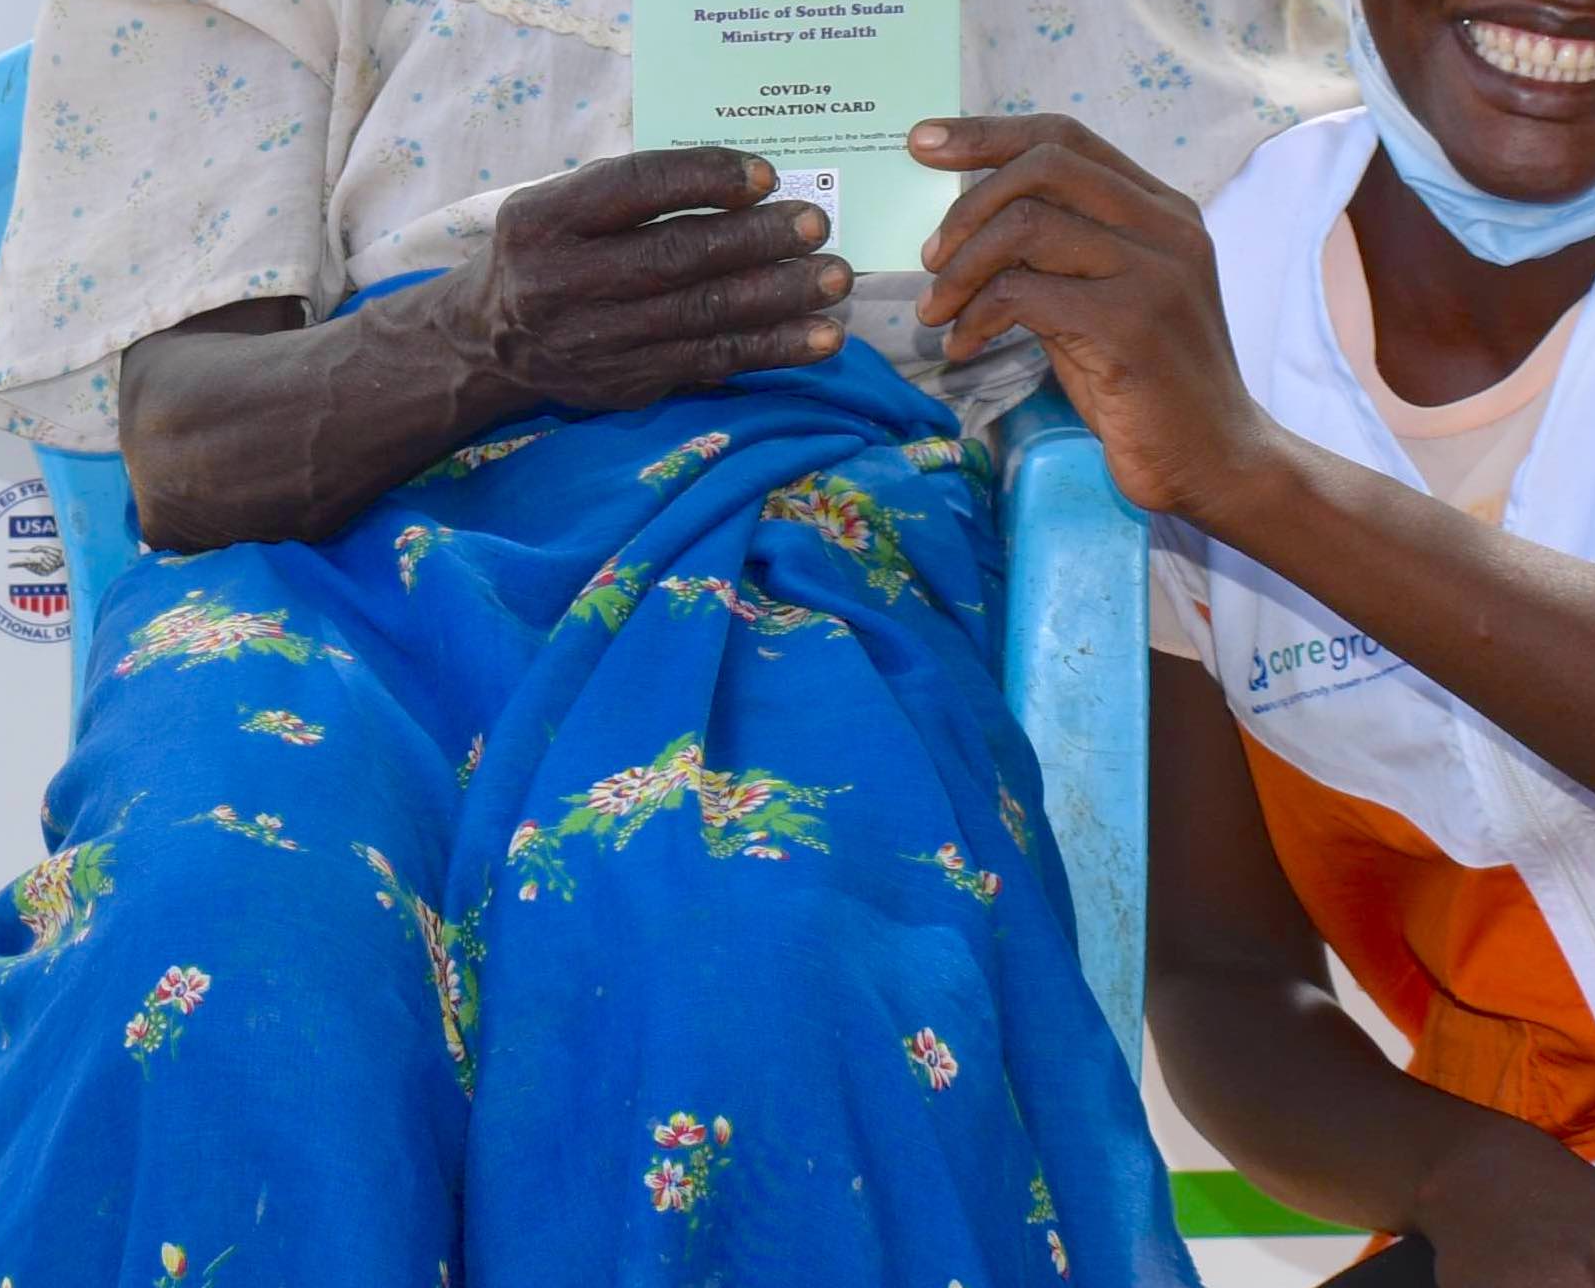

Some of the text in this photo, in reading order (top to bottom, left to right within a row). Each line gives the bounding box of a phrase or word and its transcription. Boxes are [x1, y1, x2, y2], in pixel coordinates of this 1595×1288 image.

[694, 2, 905, 24] Republic of South Sudan
[721, 25, 878, 44] Ministry of Health
[759, 83, 832, 97] COVID-19
[715, 101, 876, 118] VACCINATION CARD
[671, 138, 700, 147] Please
[700, 137, 722, 148] keep
[723, 137, 738, 146] this
[738, 136, 760, 146] card
[761, 135, 778, 144] safe
[780, 135, 797, 144] and
[798, 133, 833, 145] produce
[835, 133, 844, 141] to
[846, 132, 859, 141] the
[860, 131, 887, 140] health
[783, 146, 797, 155] the
